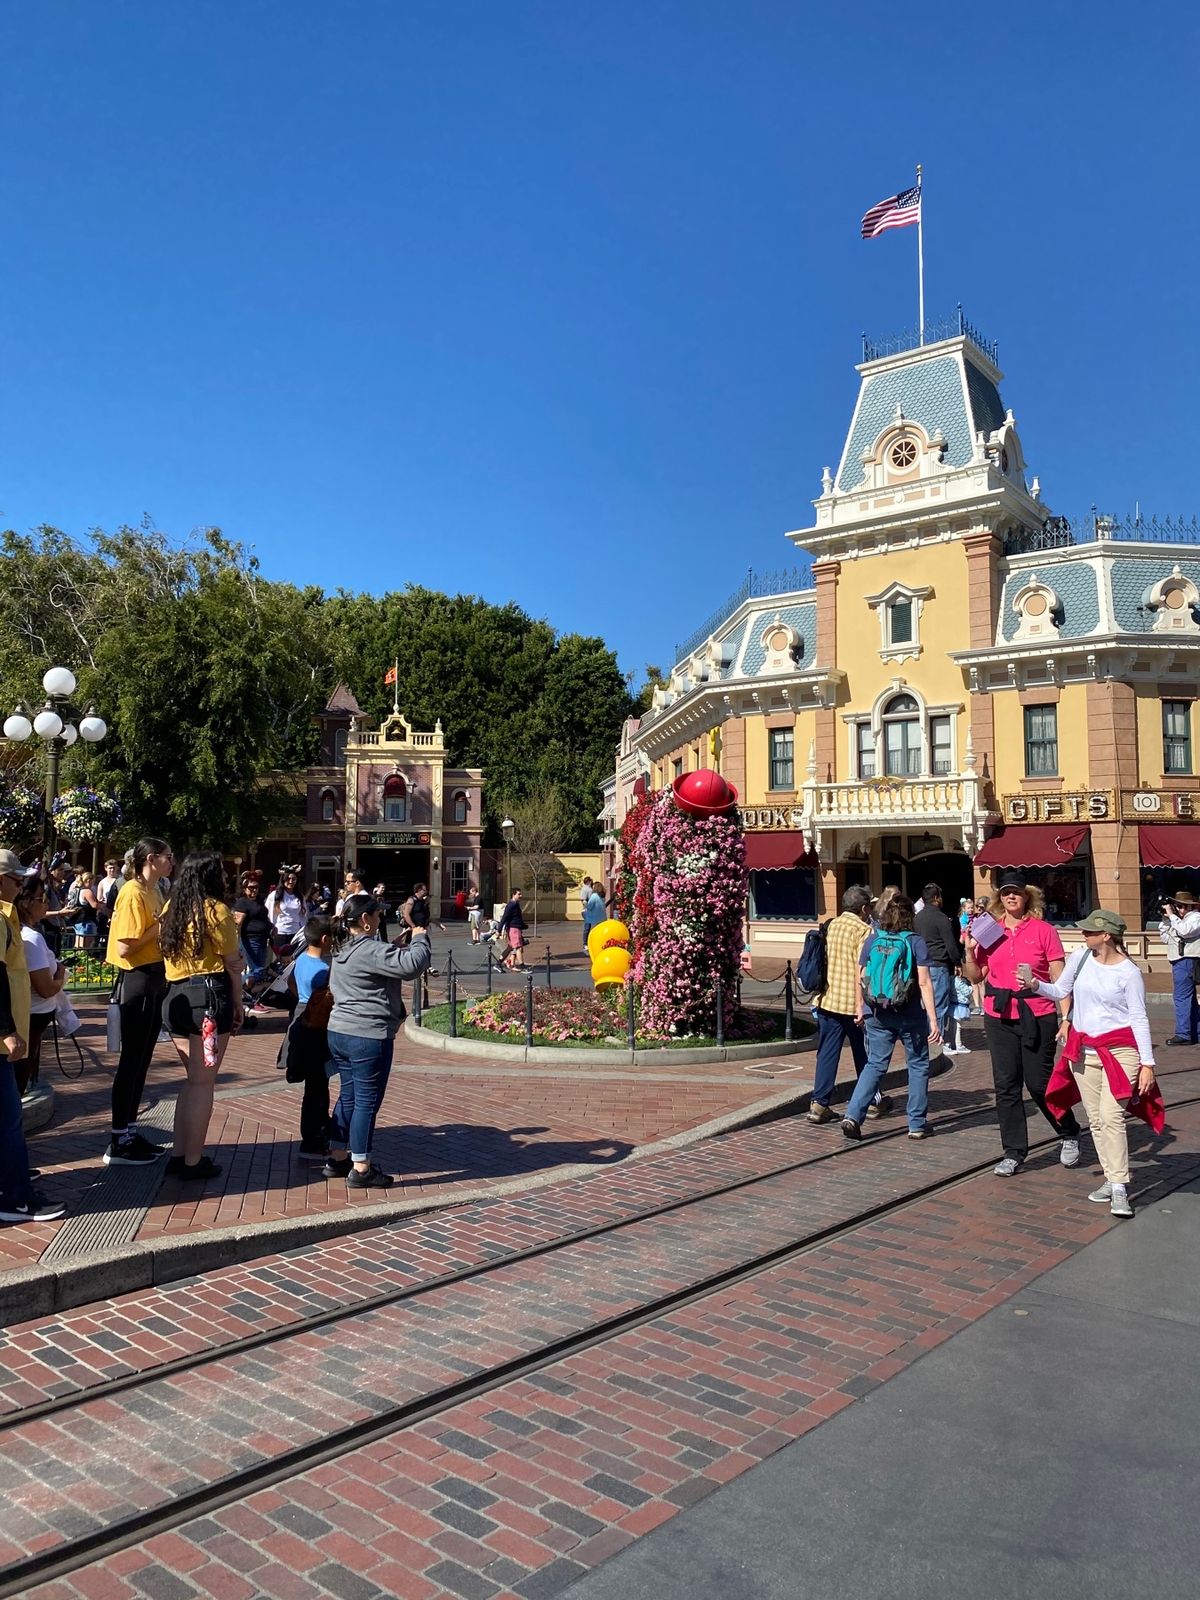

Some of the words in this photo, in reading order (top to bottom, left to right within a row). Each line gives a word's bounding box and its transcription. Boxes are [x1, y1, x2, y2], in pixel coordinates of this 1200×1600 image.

[1009, 794, 1108, 819] GIFTS
[1137, 796, 1157, 808] 101
[741, 808, 803, 827] OOKS
